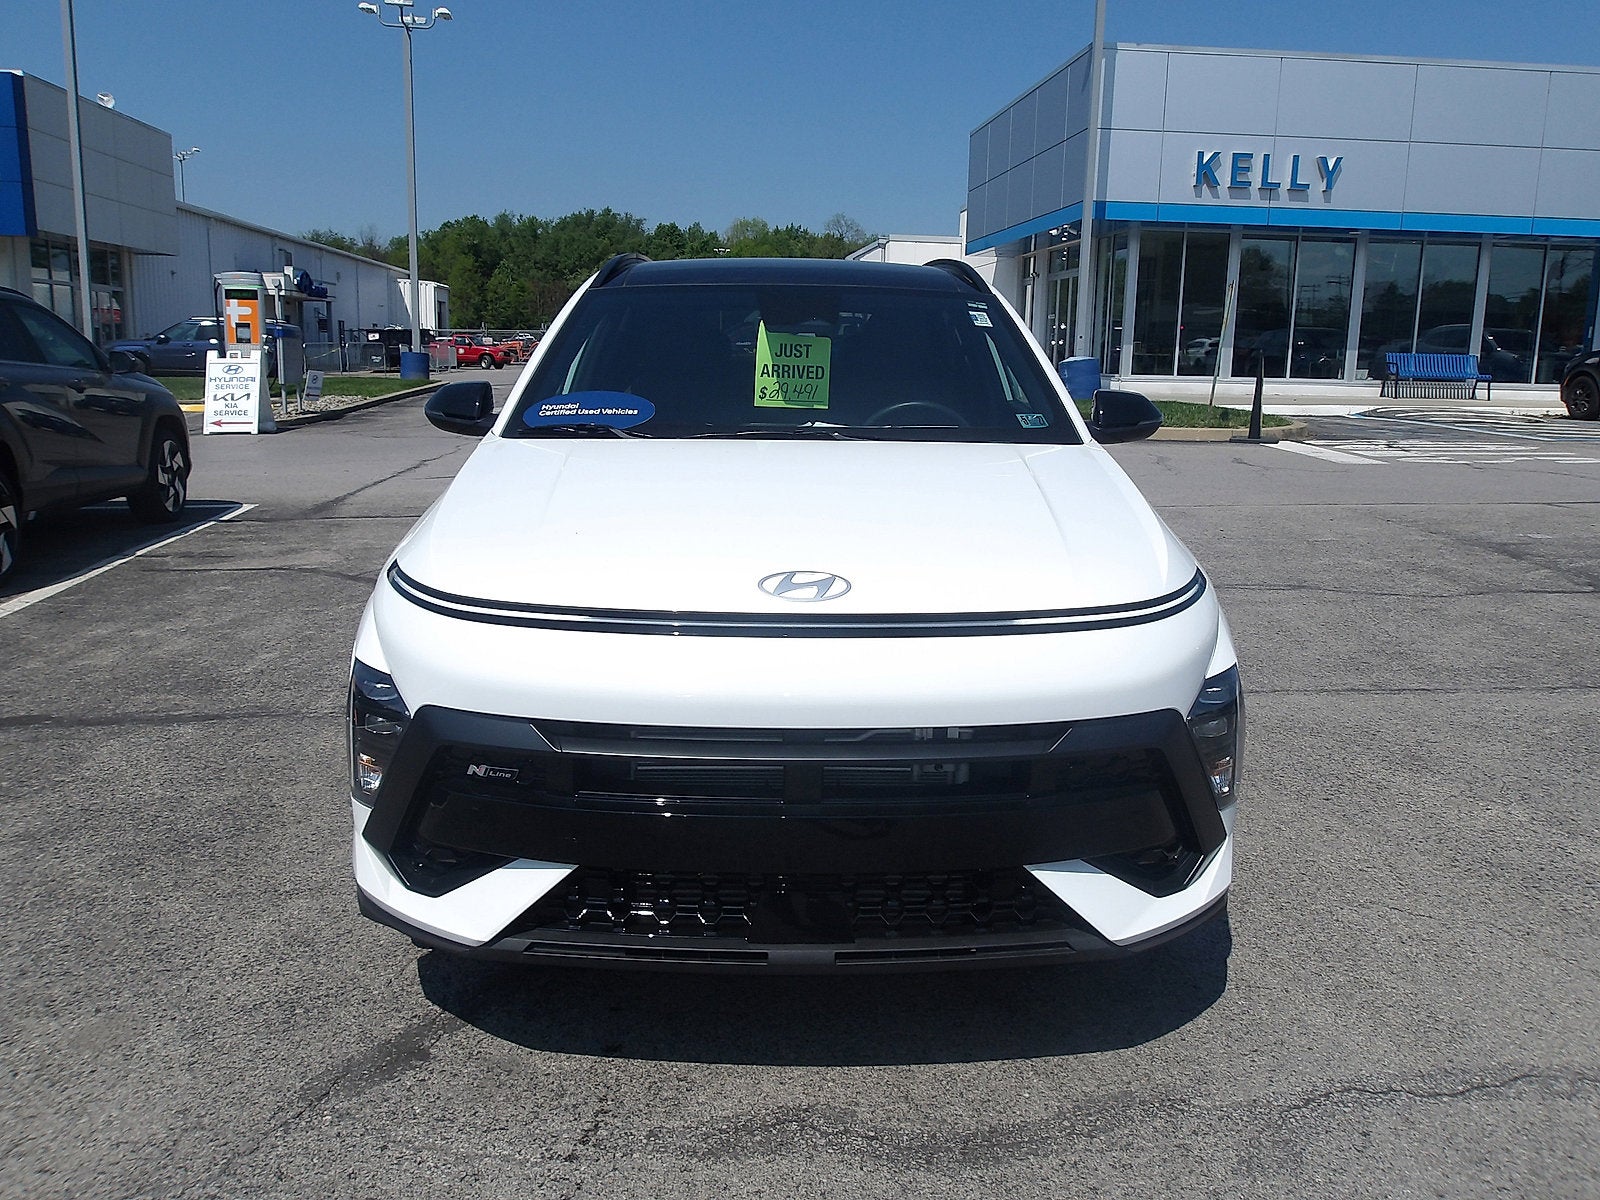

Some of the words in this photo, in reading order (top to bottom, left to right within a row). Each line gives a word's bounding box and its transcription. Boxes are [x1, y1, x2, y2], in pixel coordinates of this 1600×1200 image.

[1195, 150, 1344, 191] KELLY
[775, 343, 812, 358] JUST
[760, 364, 825, 380] ARRIVED
[538, 408, 577, 416] Certified
[601, 407, 639, 415] Vehicles
[541, 402, 580, 411] Hyundai
[489, 770, 512, 778] Line
